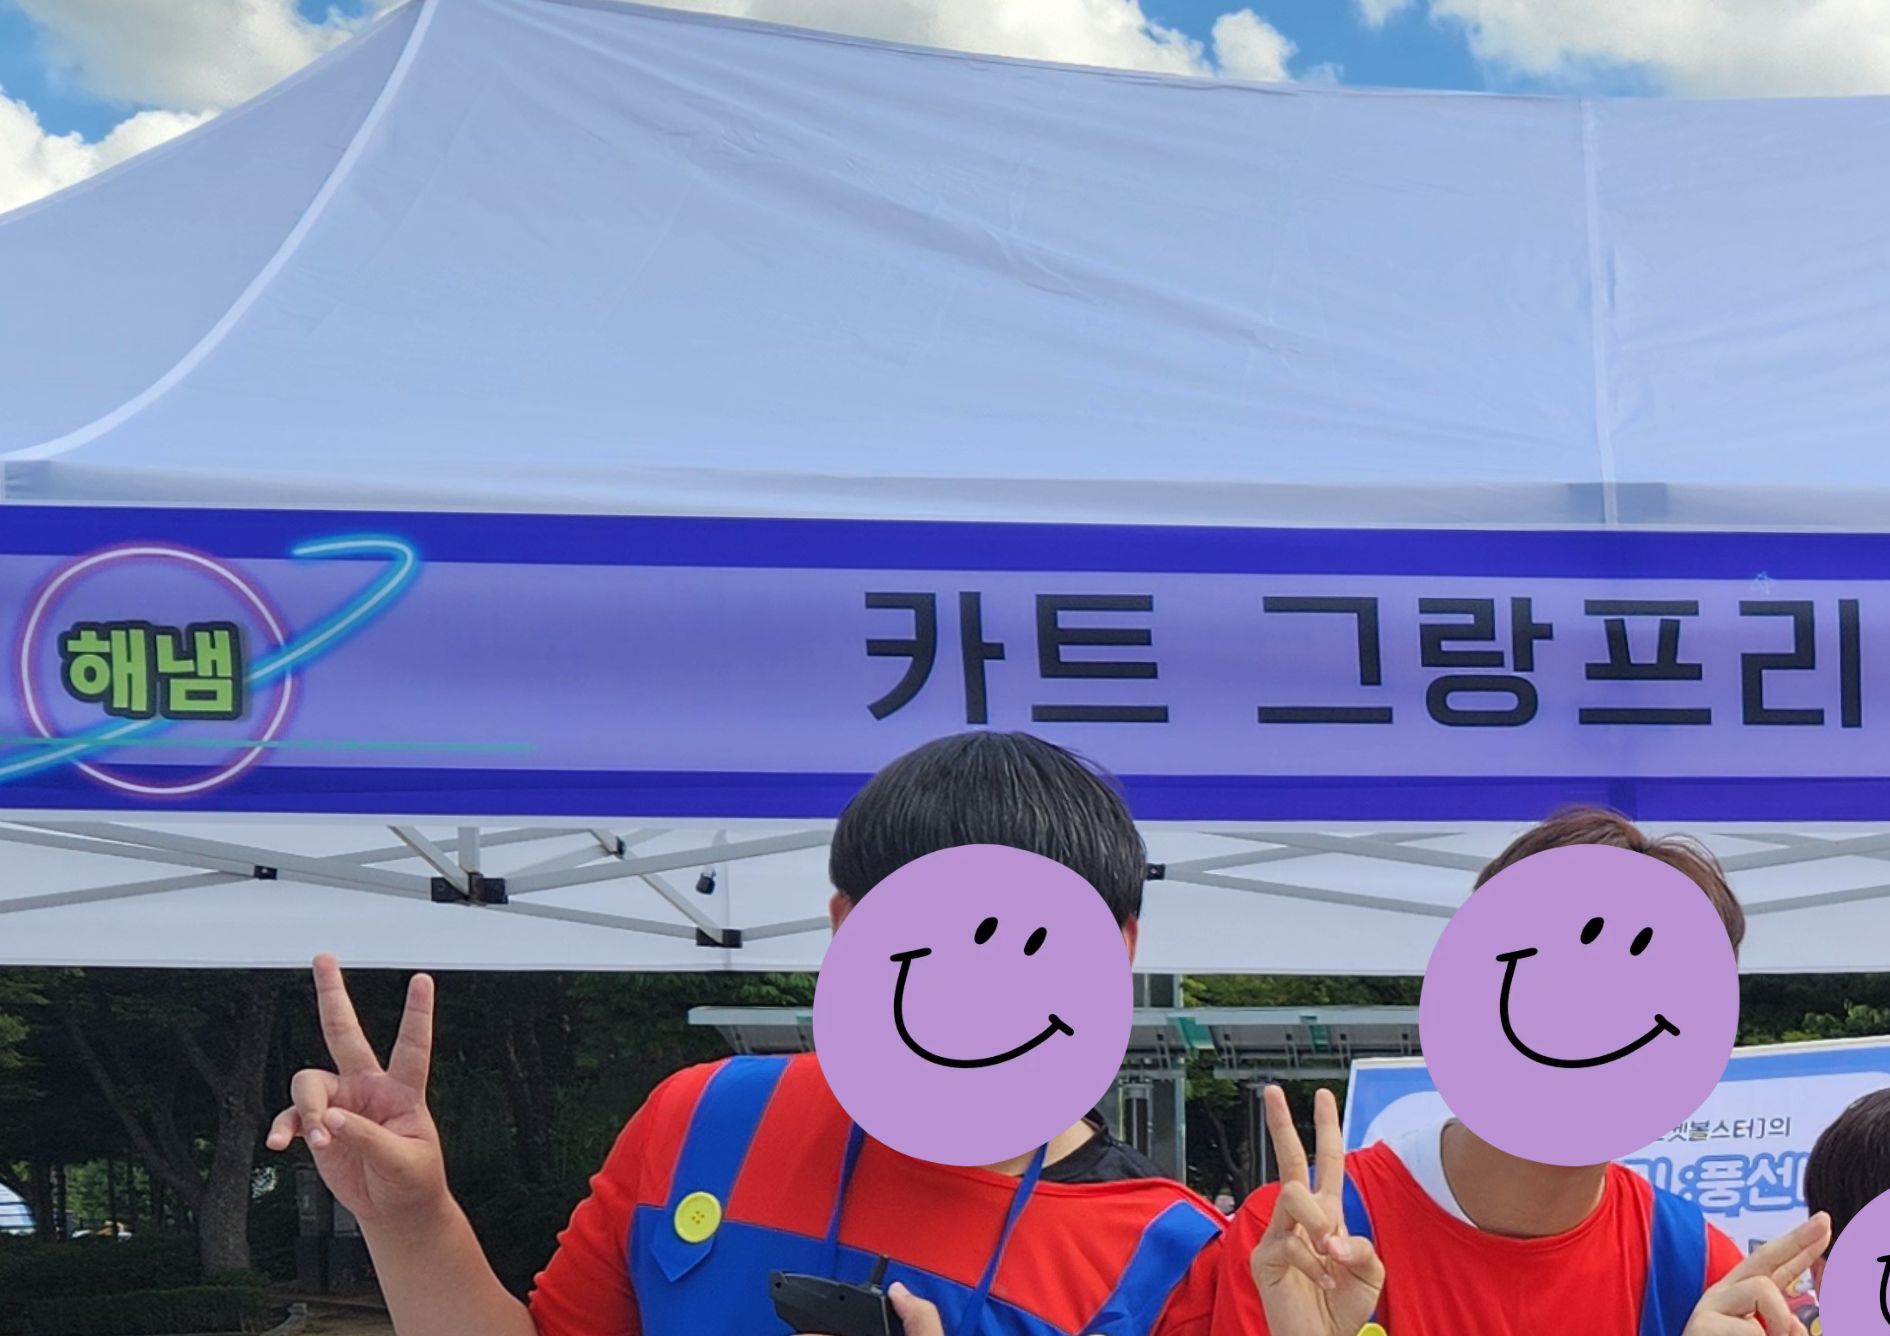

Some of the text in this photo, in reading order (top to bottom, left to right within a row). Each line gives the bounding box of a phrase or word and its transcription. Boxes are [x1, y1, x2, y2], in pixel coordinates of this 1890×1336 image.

[62, 622, 240, 717] 해냄
[865, 591, 1169, 725] 카트
[1258, 595, 1862, 728] 그랑프리
[1656, 1117, 1790, 1142] 볼스터]의
